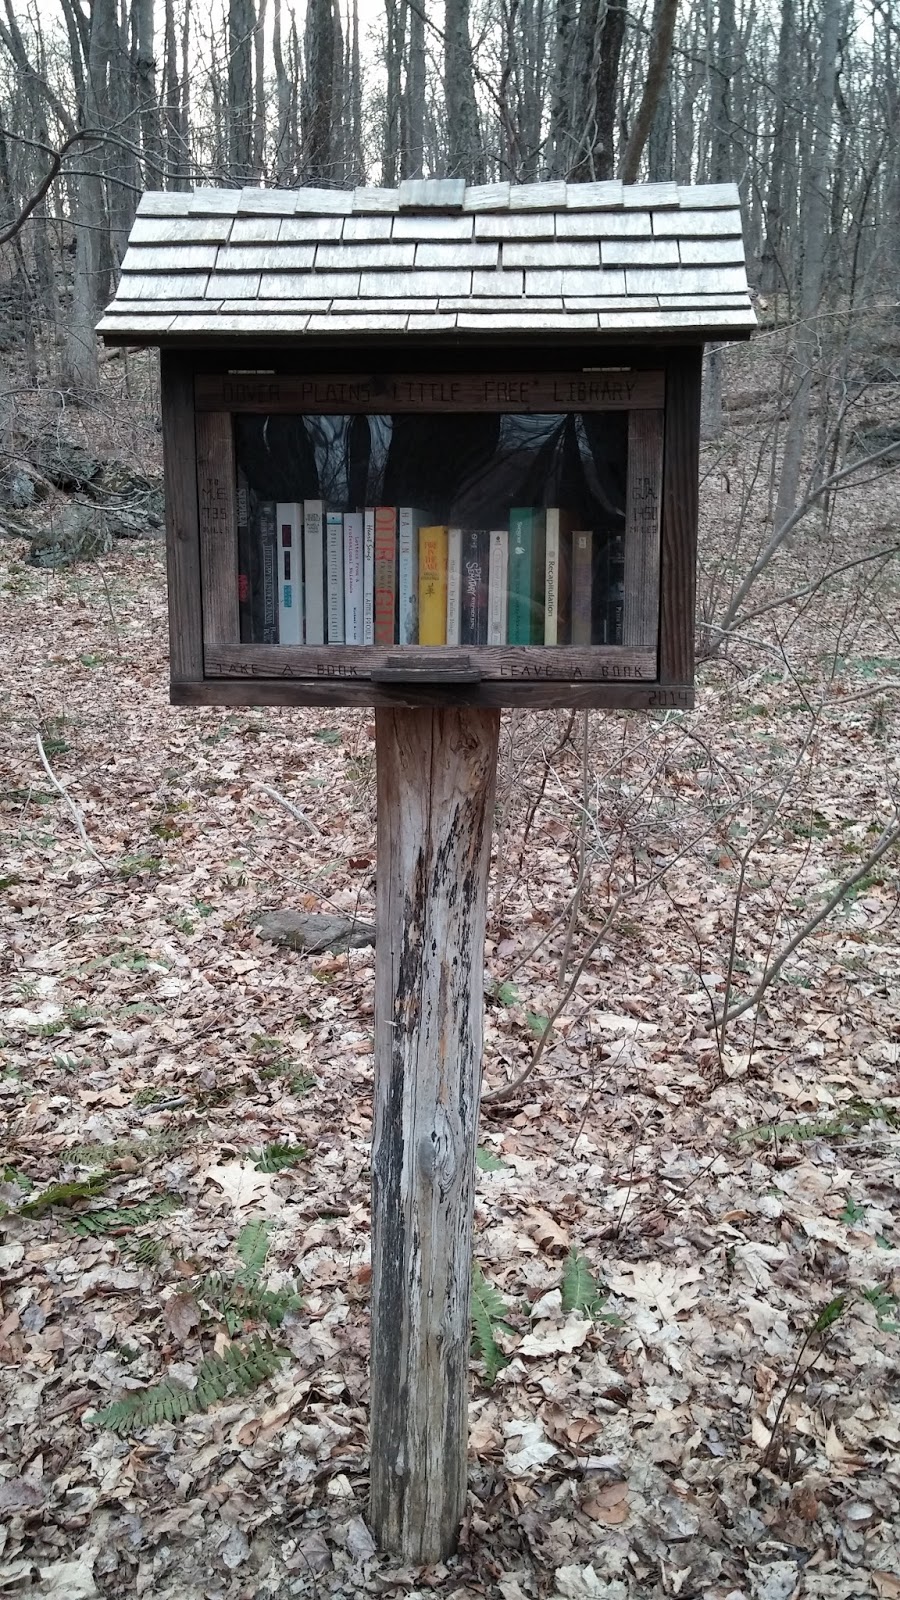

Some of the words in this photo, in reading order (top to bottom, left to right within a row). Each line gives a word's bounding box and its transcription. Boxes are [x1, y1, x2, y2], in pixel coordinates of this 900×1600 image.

[302, 382, 371, 402] PLAINS
[392, 382, 460, 402] LITTLE
[484, 381, 530, 402] FREE
[553, 381, 637, 402] LIBRARY
[236, 488, 248, 527] STEPHEN
[401, 512, 410, 527] HA
[376, 507, 396, 561] OUR
[515, 521, 523, 545] Stegner
[364, 544, 374, 561] Songs
[401, 534, 410, 554] JIN
[546, 560, 556, 617] Recapitulation
[215, 663, 258, 674] TAKE
[282, 664, 294, 675] A
[316, 664, 358, 675] BOOK
[500, 665, 553, 677] LEAVE
[573, 666, 583, 677] A
[602, 665, 643, 678] BOOK
[648, 690, 689, 706] 2014
